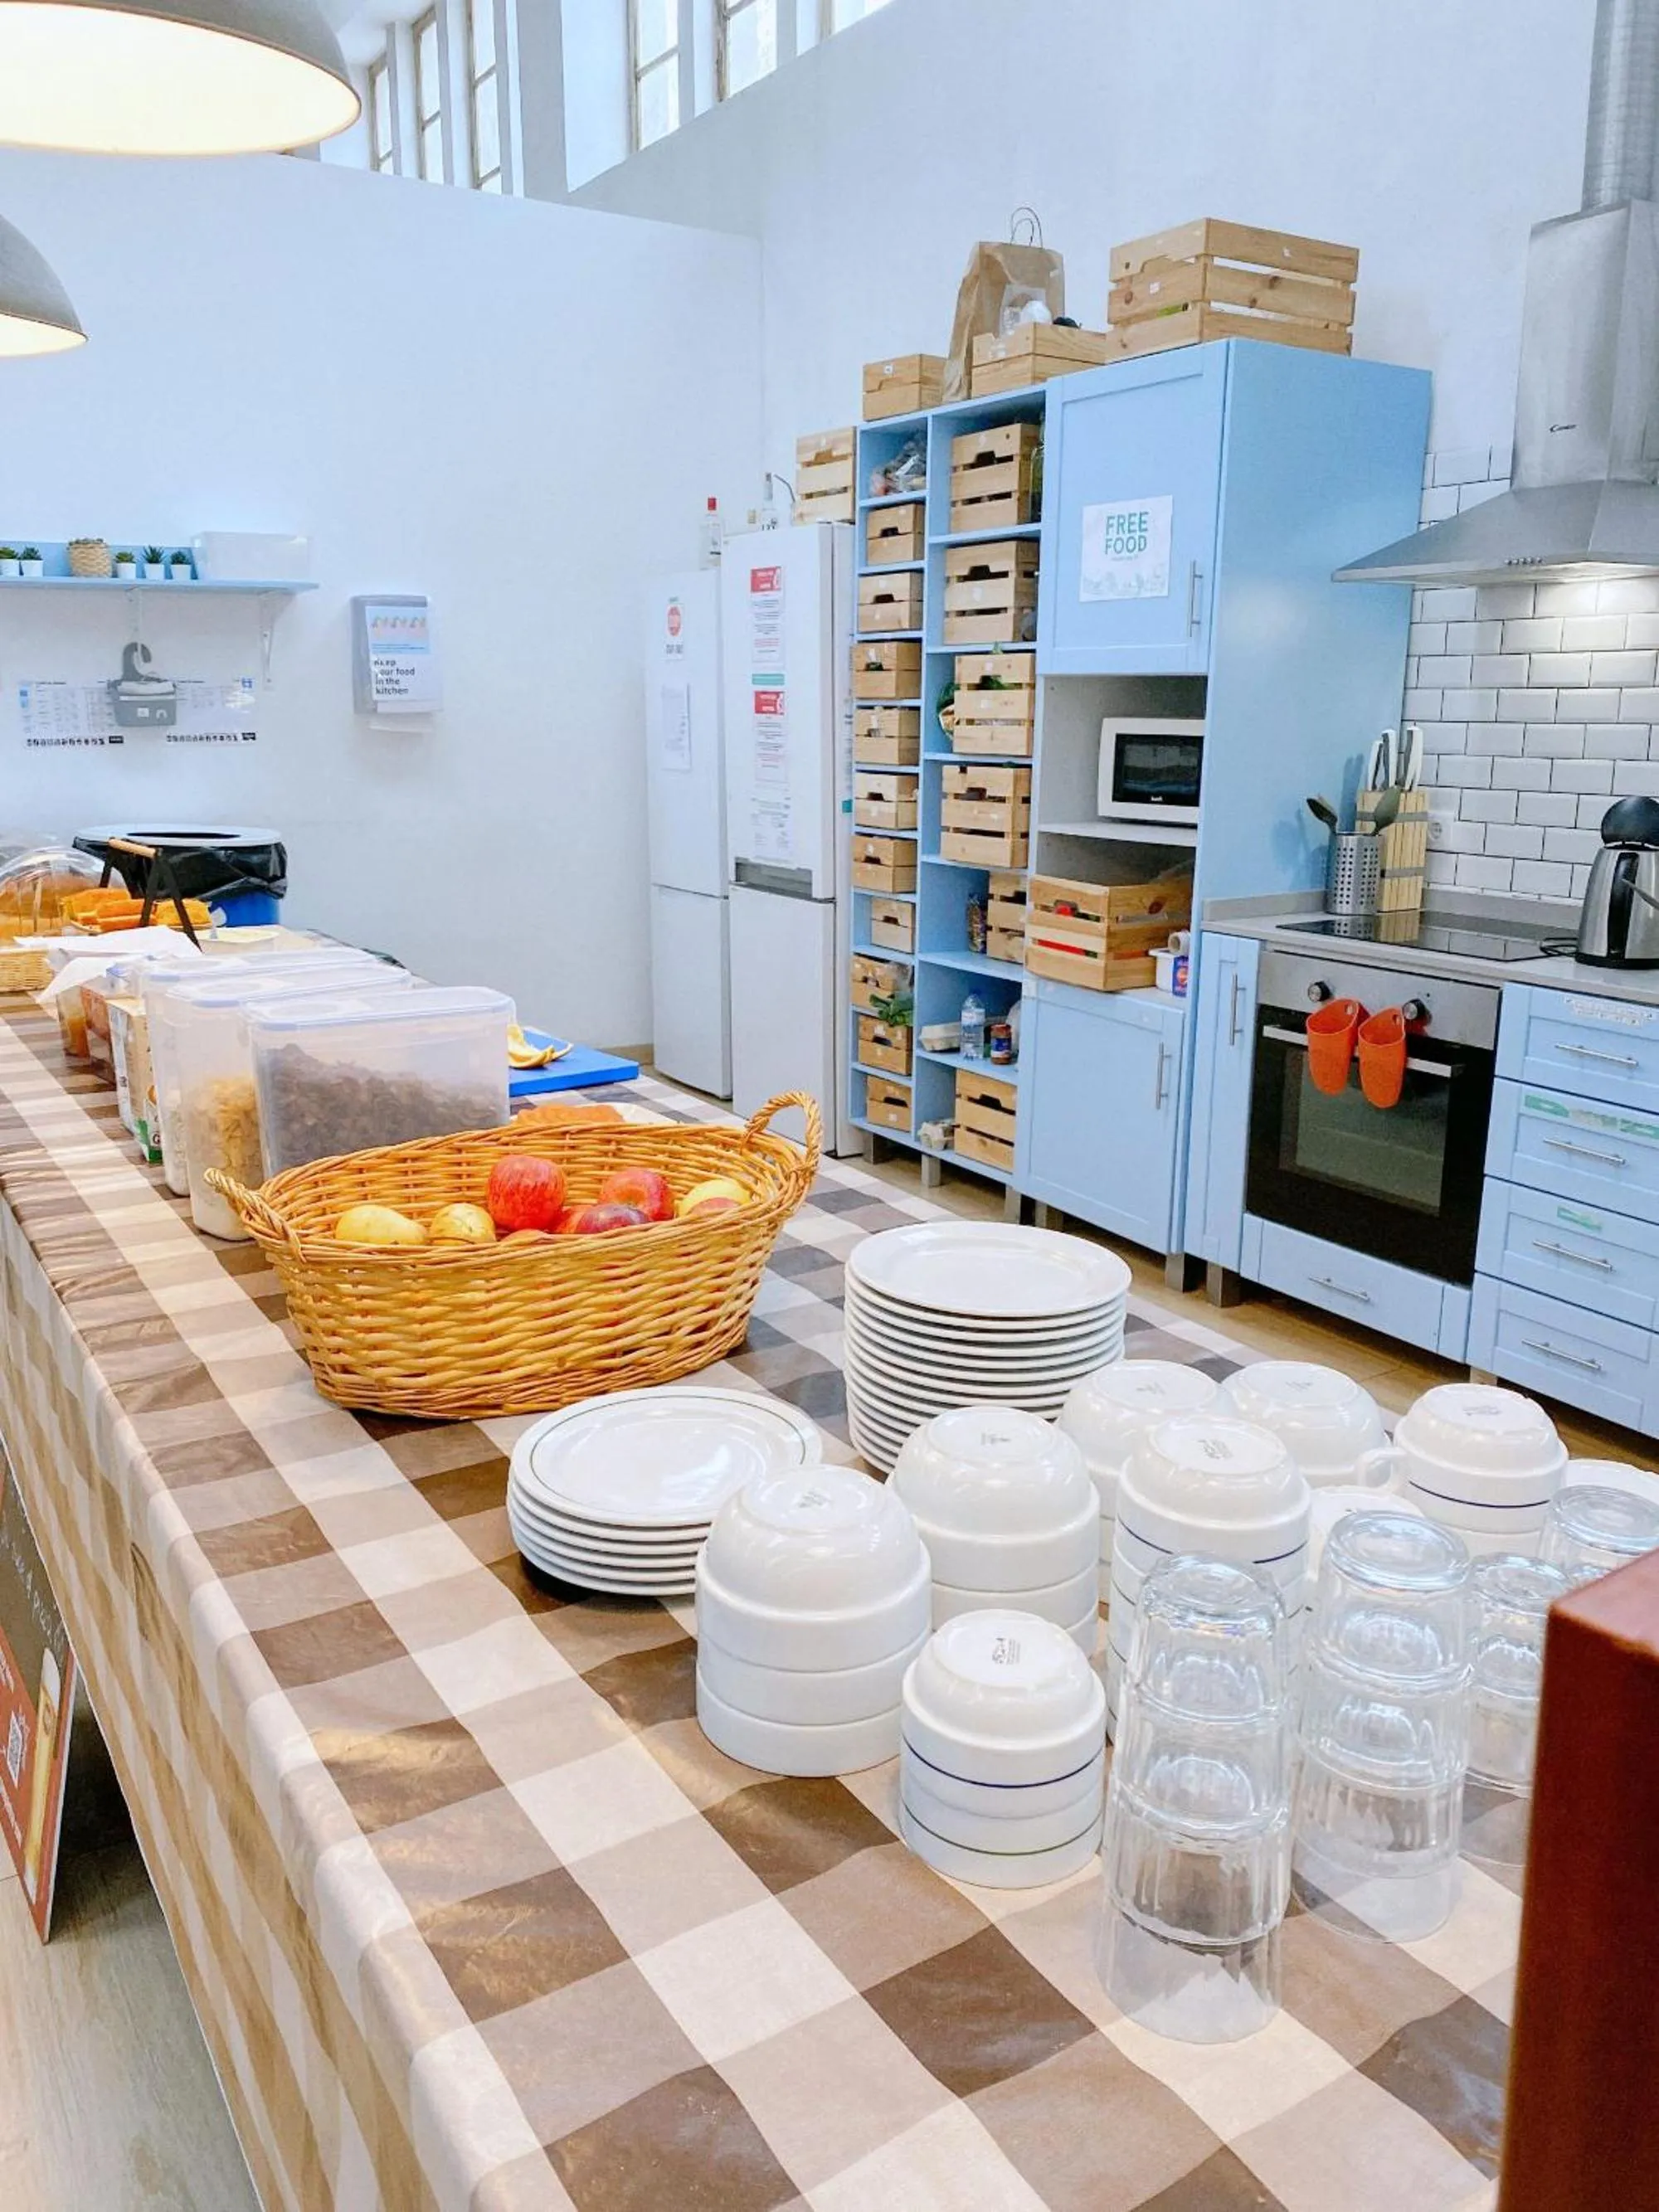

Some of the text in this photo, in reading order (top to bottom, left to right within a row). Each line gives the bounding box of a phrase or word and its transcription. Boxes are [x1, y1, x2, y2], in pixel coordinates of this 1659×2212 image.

[1106, 510, 1150, 535] FREE
[1104, 535, 1147, 555] FOOD
[396, 667, 415, 676] food
[375, 686, 409, 695] kitchen
